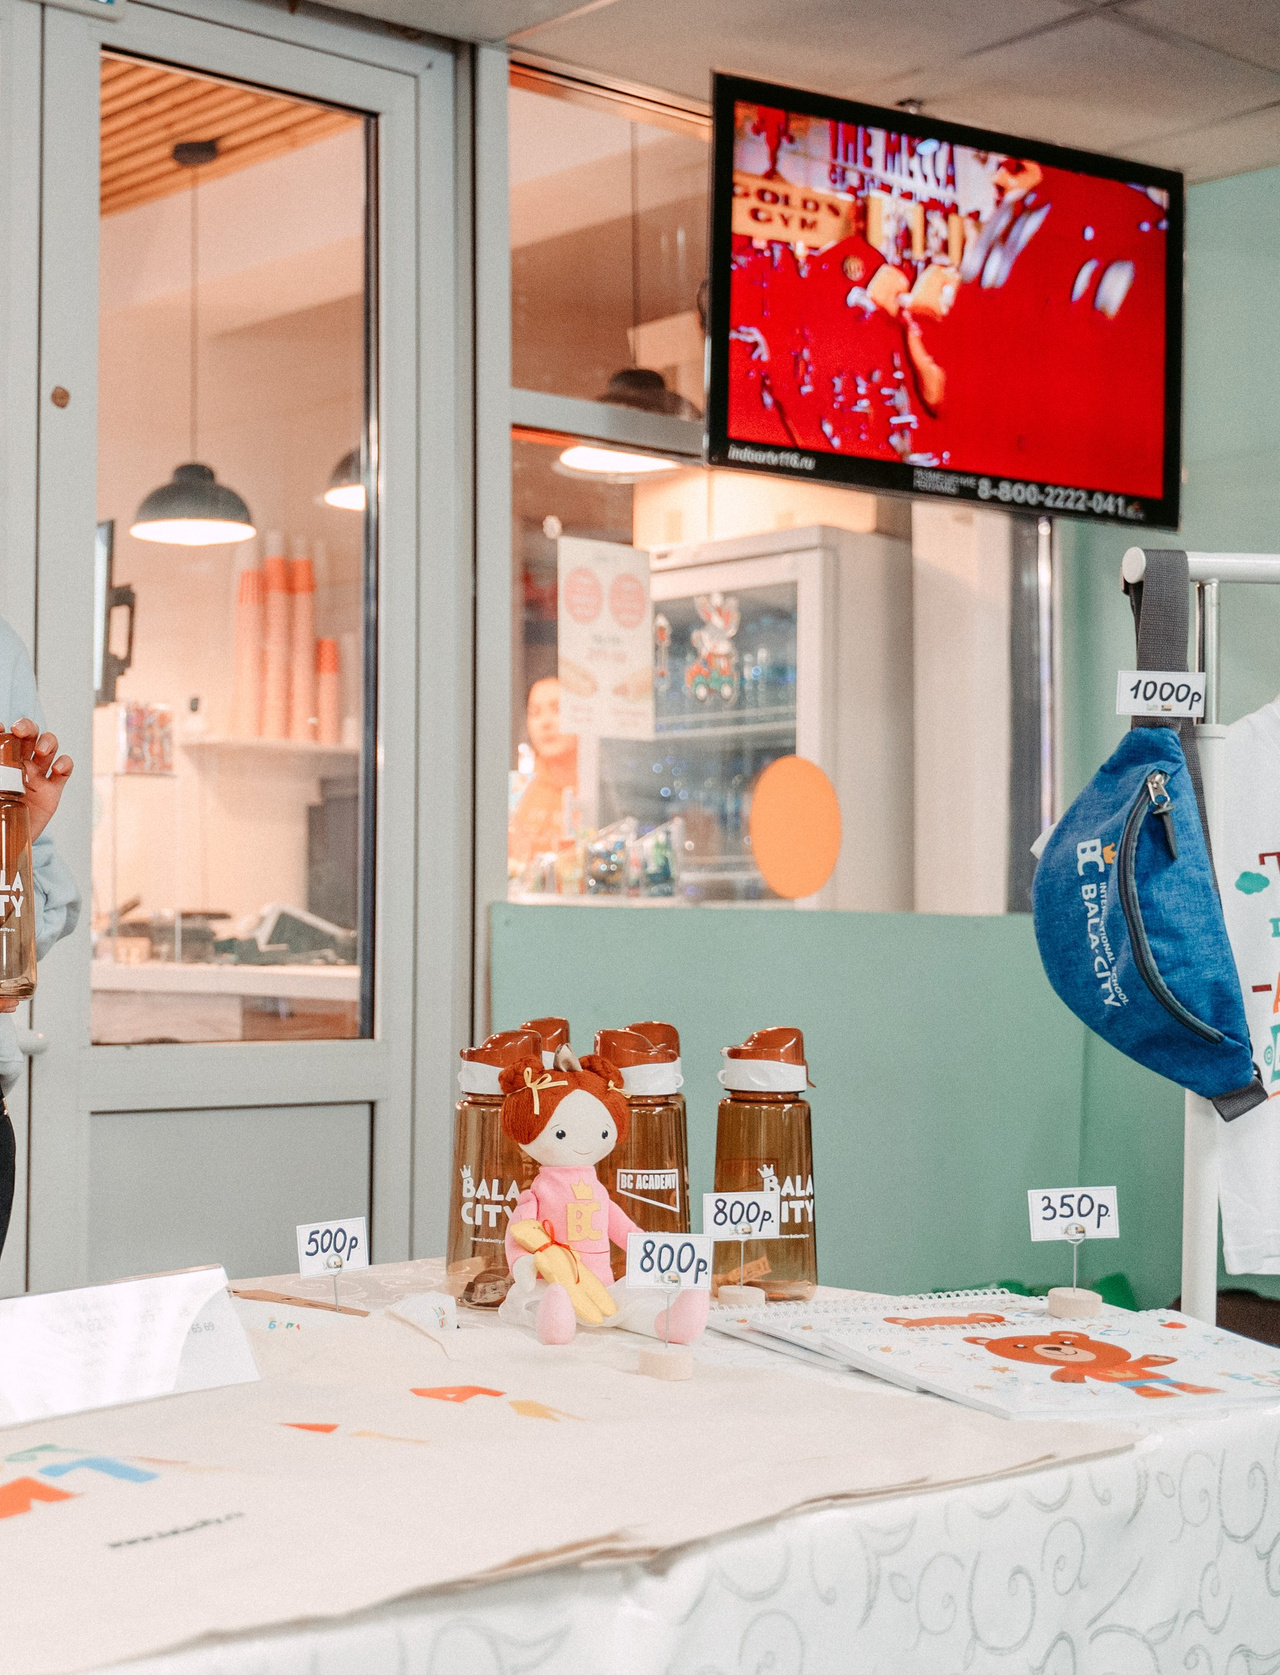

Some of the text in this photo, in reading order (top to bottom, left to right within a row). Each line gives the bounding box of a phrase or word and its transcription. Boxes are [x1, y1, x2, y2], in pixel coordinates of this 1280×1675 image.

[749, 207, 818, 230] GYM
[977, 477, 1127, 517] 8-800-2222-041
[1076, 838, 1105, 876] BC
[1080, 883, 1122, 1007] BALA-CITY
[462, 1176, 521, 1202] BALA
[620, 1173, 677, 1190] BC ACADEMY
[763, 1174, 814, 1197] BALA
[567, 1202, 602, 1242] BC
[713, 1198, 775, 1232] 800р.
[780, 1199, 814, 1223] ITY
[1041, 1194, 1111, 1229] 350р.
[640, 1239, 708, 1284] 800р.
